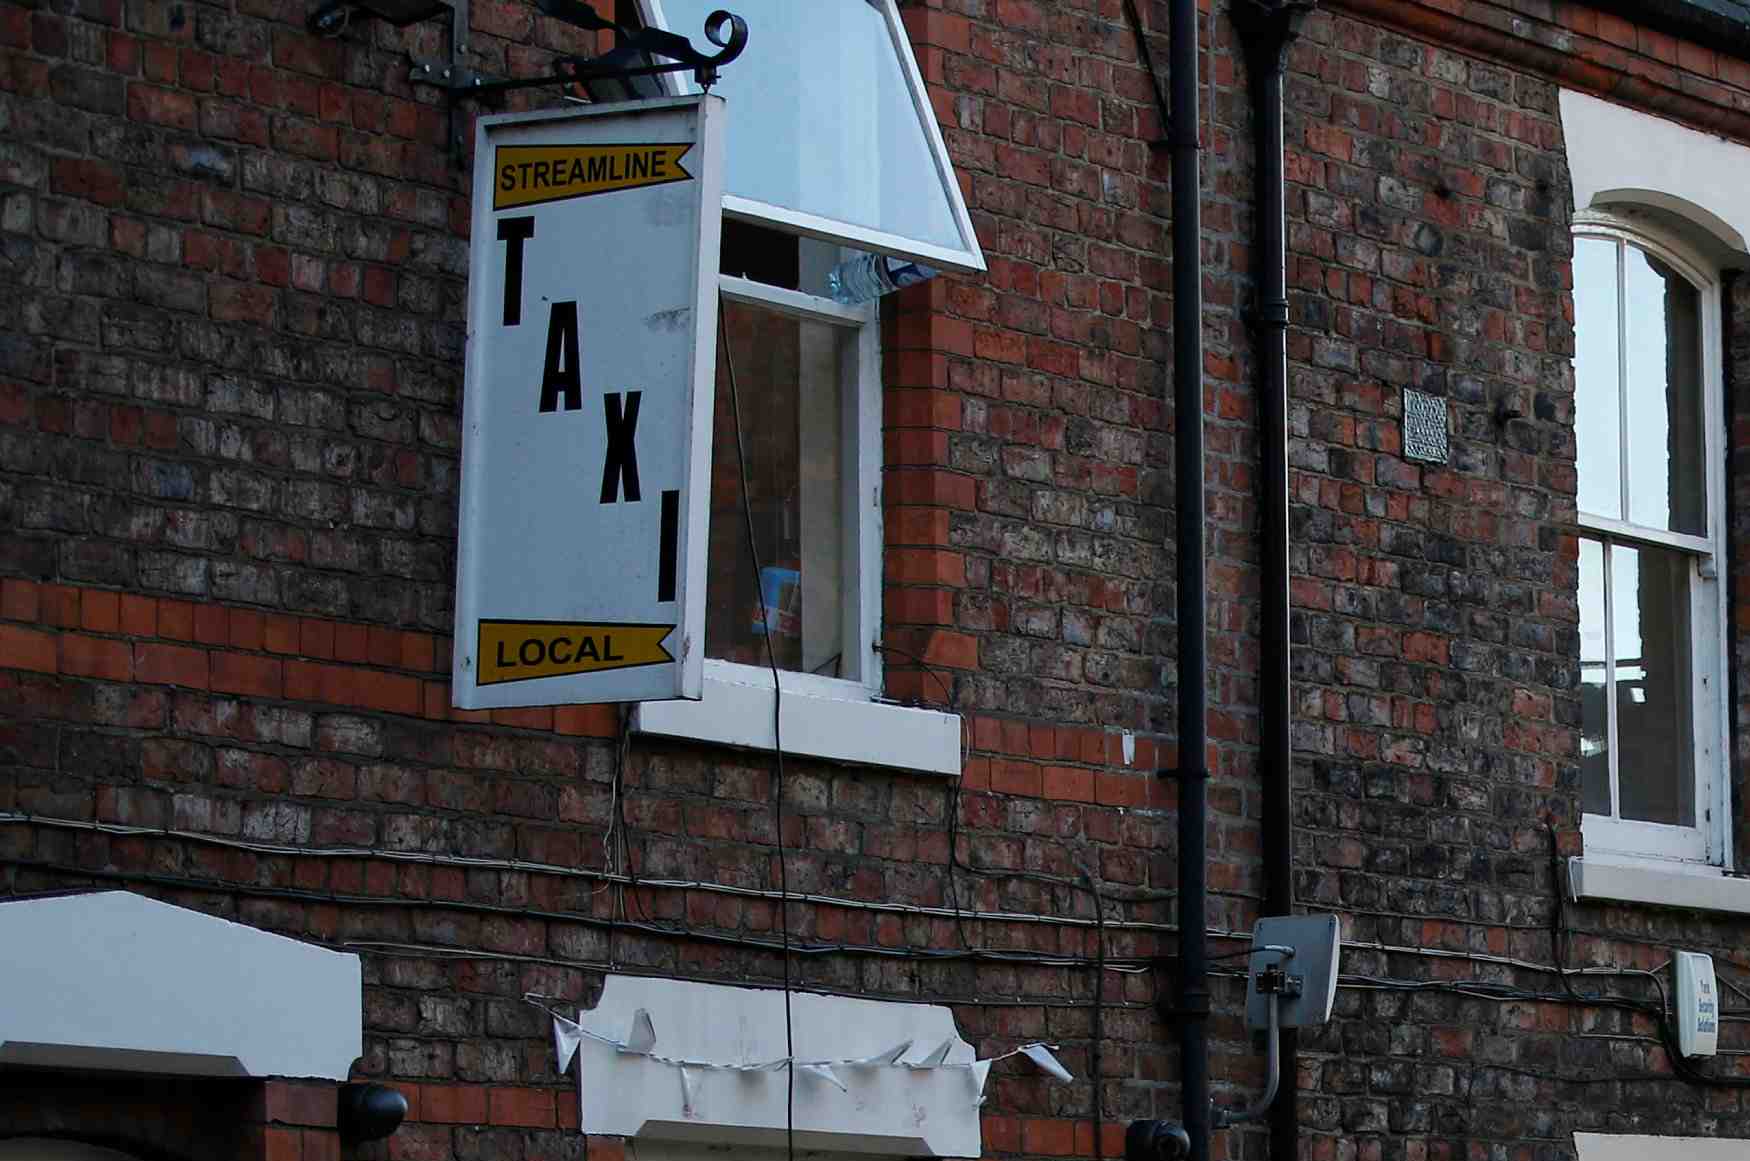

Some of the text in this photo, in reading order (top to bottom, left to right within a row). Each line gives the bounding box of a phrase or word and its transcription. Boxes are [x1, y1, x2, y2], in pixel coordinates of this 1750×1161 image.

[499, 148, 667, 192] STREAMLINE
[496, 215, 680, 604] TAXI
[496, 633, 624, 668] LOCAL
